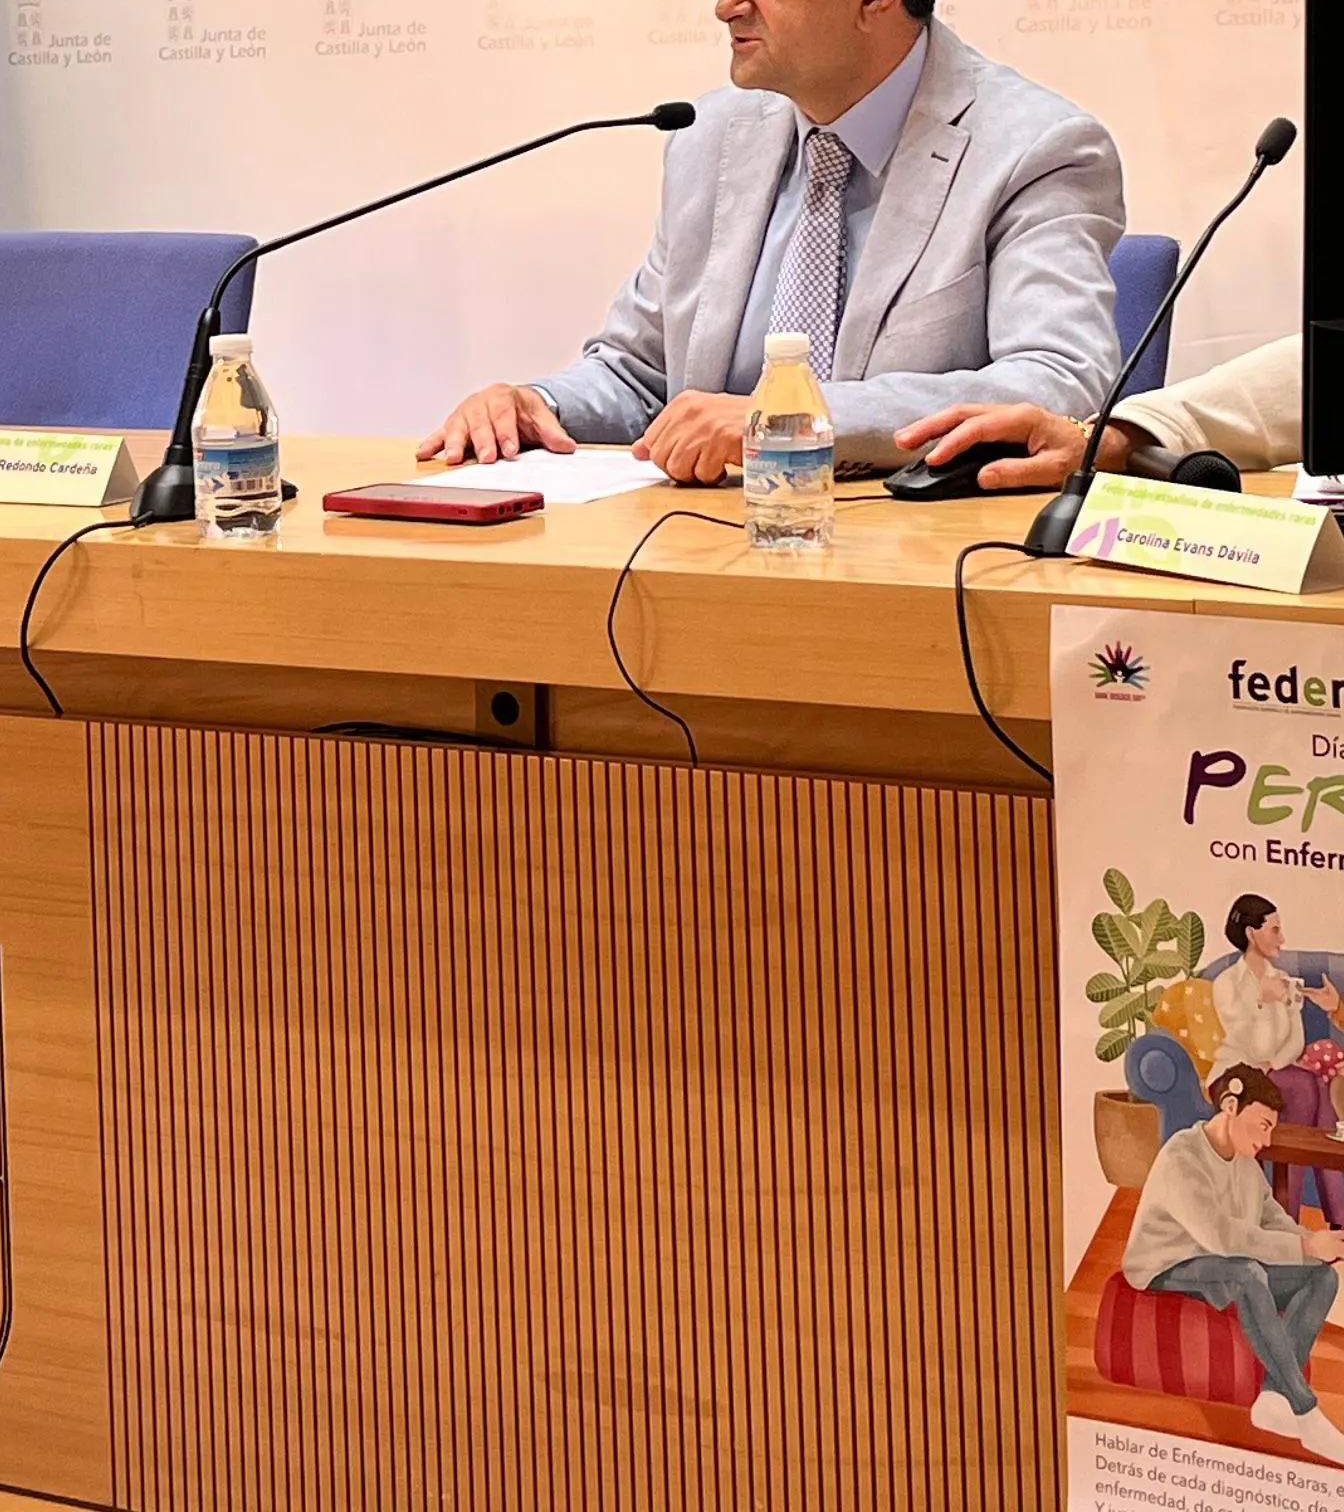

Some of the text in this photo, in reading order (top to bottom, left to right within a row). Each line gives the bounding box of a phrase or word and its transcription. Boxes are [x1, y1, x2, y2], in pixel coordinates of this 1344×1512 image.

[50, 461, 98, 475] Cardeña
[1117, 528, 1261, 565] Carolina Evans Dávila
[1210, 840, 1256, 861] con
[1096, 1432, 1144, 1455] Hablar
[1148, 1443, 1169, 1461] de
[1172, 1447, 1283, 1484] Enfermedades
[1287, 1470, 1332, 1497] Raras,
[1096, 1455, 1144, 1479] Detrás
[1147, 1466, 1167, 1484] de
[1171, 1474, 1207, 1492] cada
